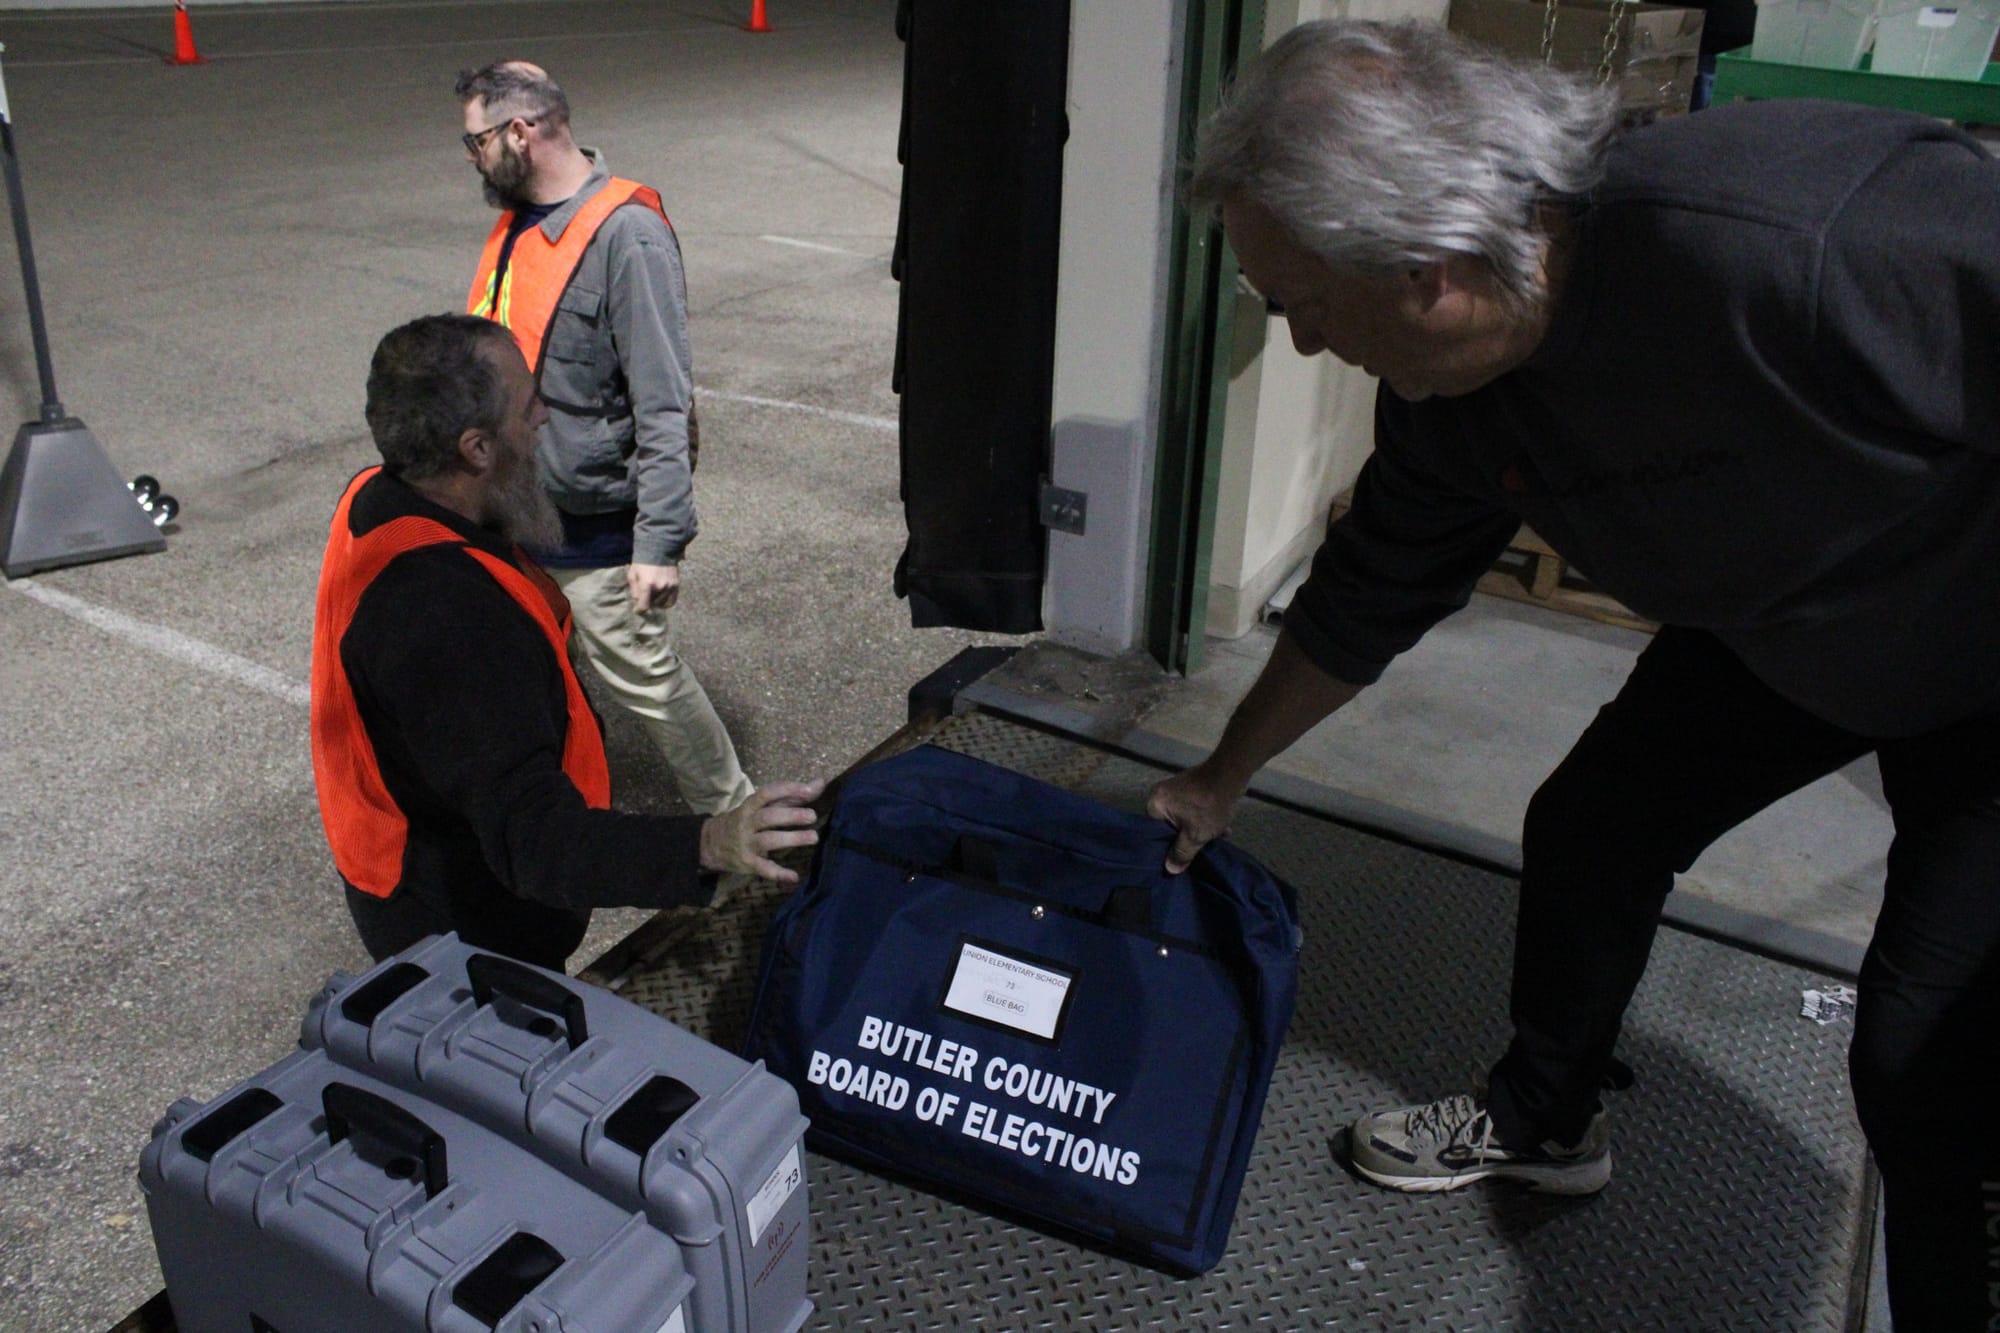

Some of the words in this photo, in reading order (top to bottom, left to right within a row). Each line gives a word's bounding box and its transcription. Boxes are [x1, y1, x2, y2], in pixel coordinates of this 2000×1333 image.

[963, 949, 989, 963] UNION
[989, 957, 1035, 977] ELEMENTARY
[1035, 973, 1066, 989] SCHOOL
[1006, 981, 1016, 990] 73
[986, 993, 1006, 1007] BLUE
[1007, 1000, 1025, 1013] BAG
[858, 1015, 978, 1083] BUTLER
[984, 1056, 1116, 1124] COUNTY
[807, 1050, 910, 1111] BOARD
[915, 1087, 960, 1126] OF
[961, 1101, 1141, 1186] ELECTIONS
[785, 1167, 799, 1193] 73
